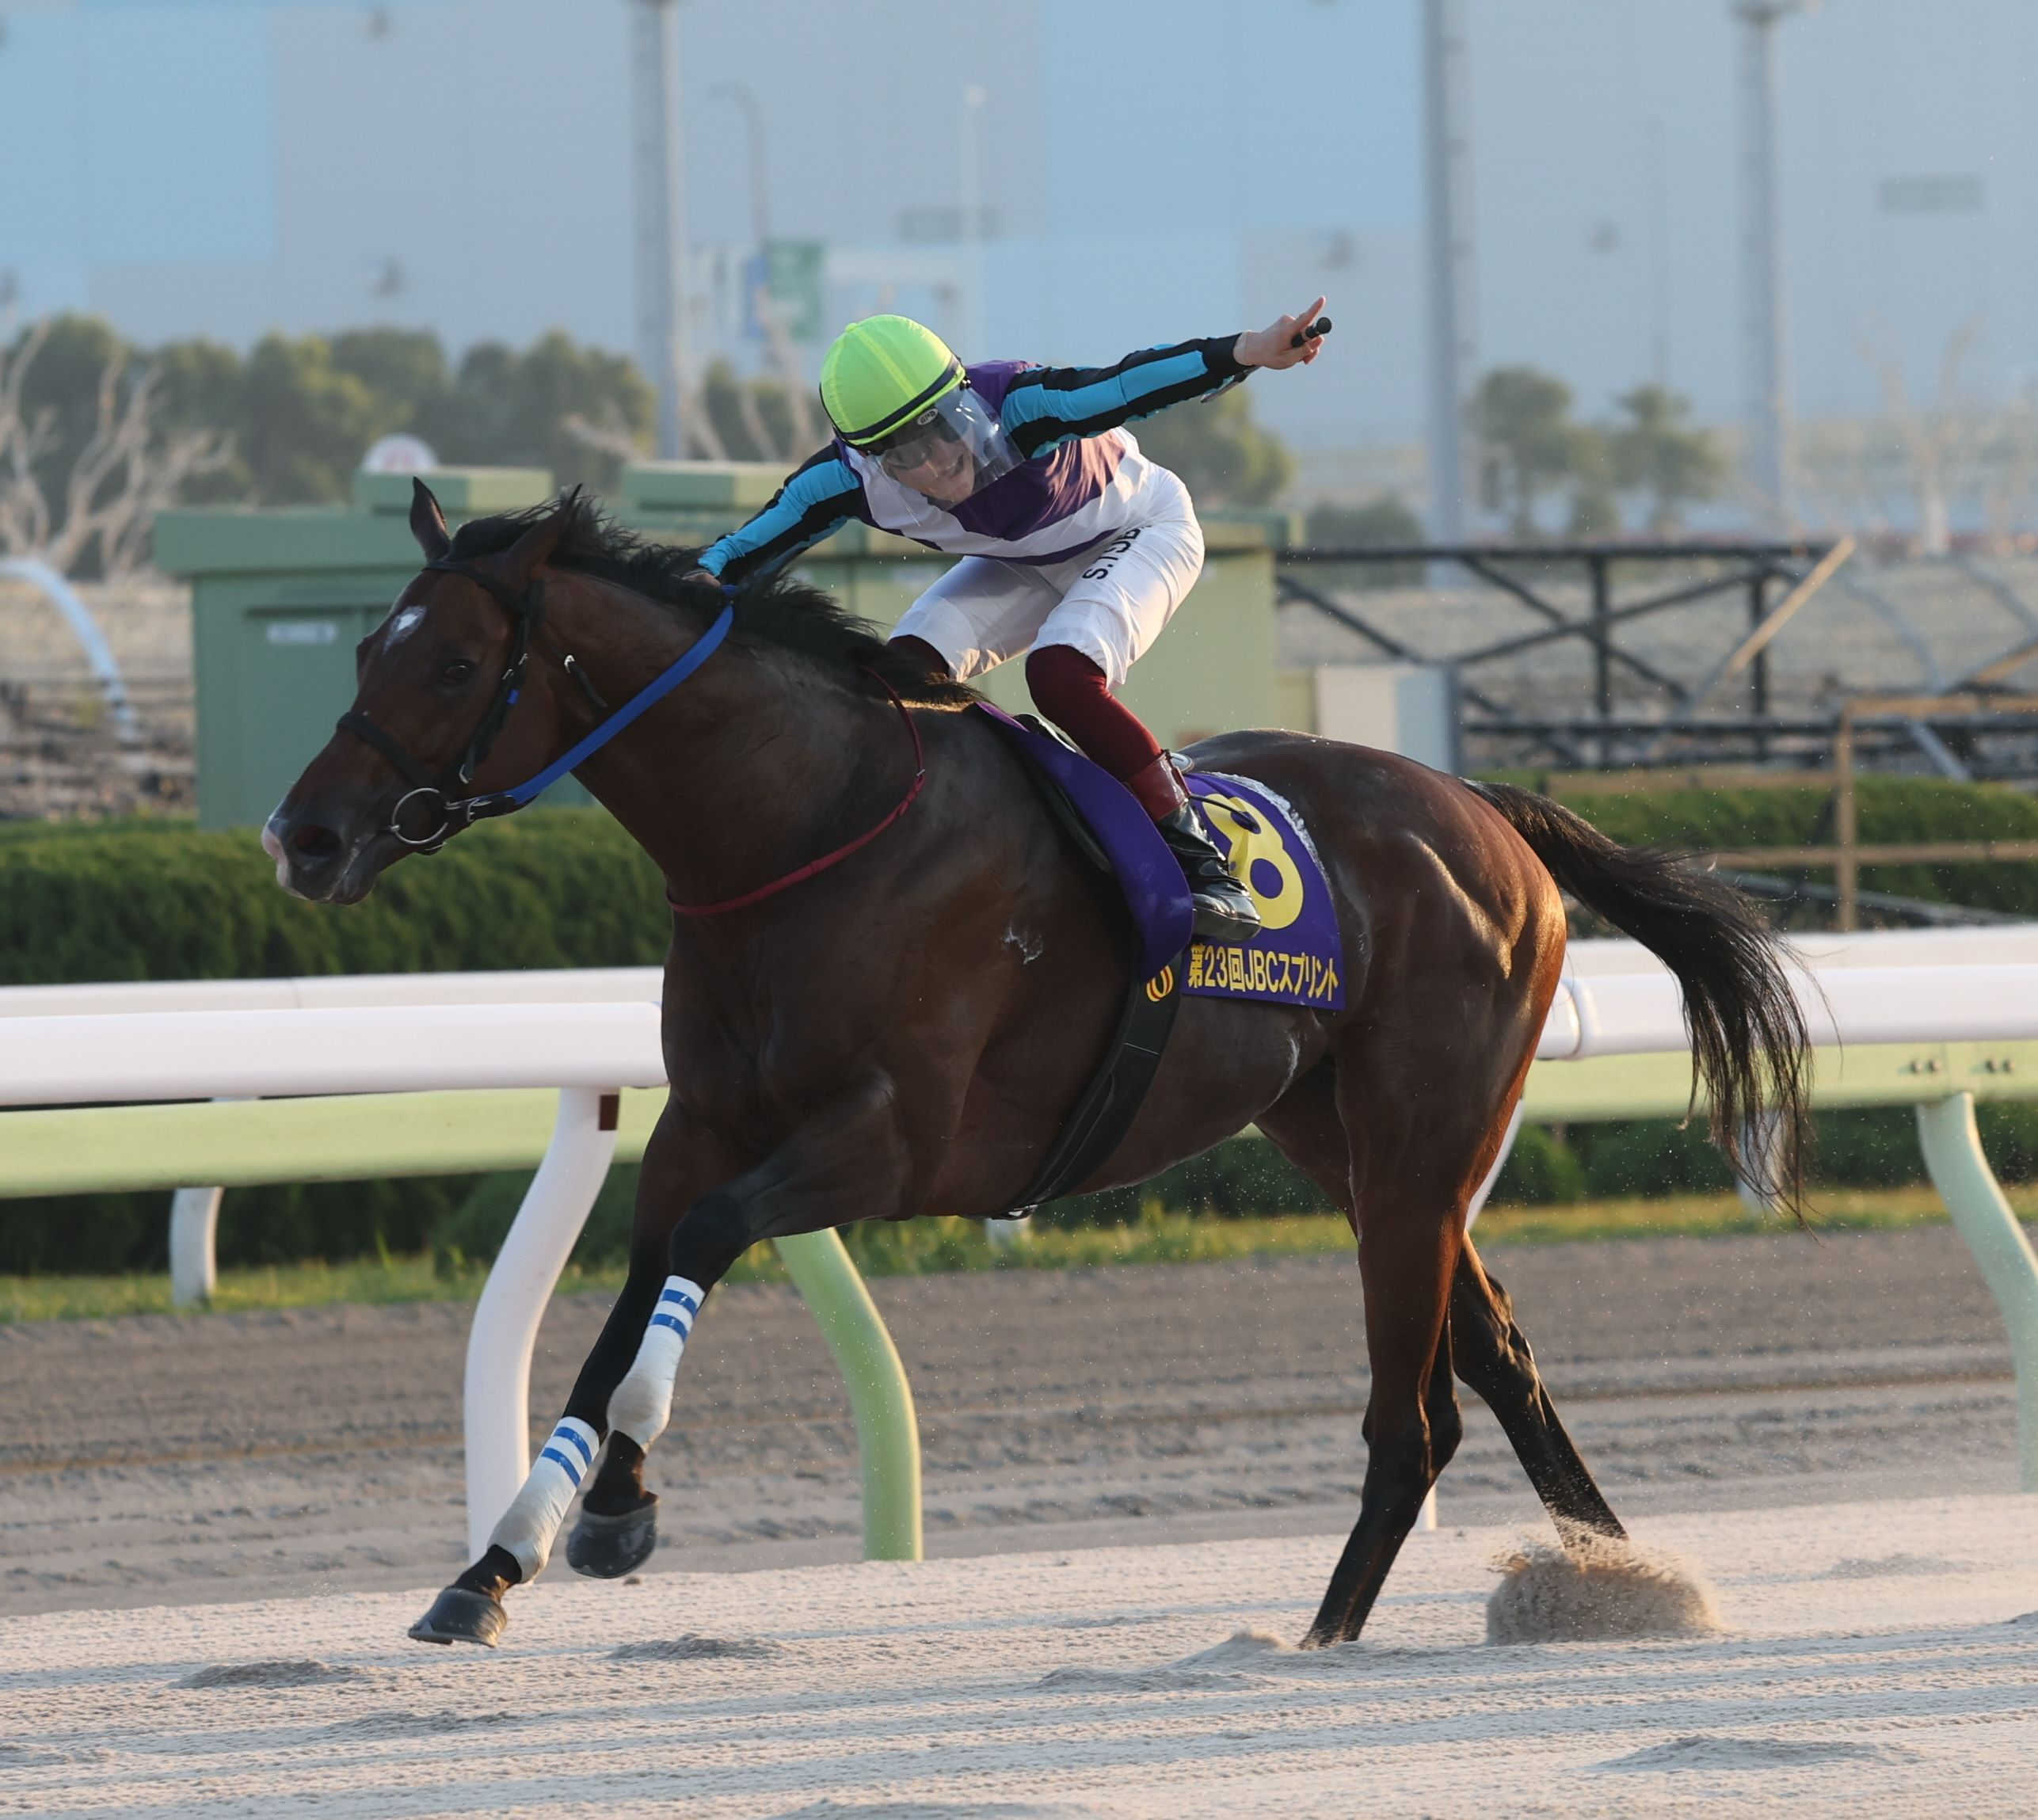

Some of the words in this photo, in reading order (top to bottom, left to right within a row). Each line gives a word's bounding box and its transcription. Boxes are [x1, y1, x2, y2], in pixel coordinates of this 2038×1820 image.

[1202, 794, 1304, 930] 8
[1188, 944, 1339, 1002] 第23回JBCスプリント
